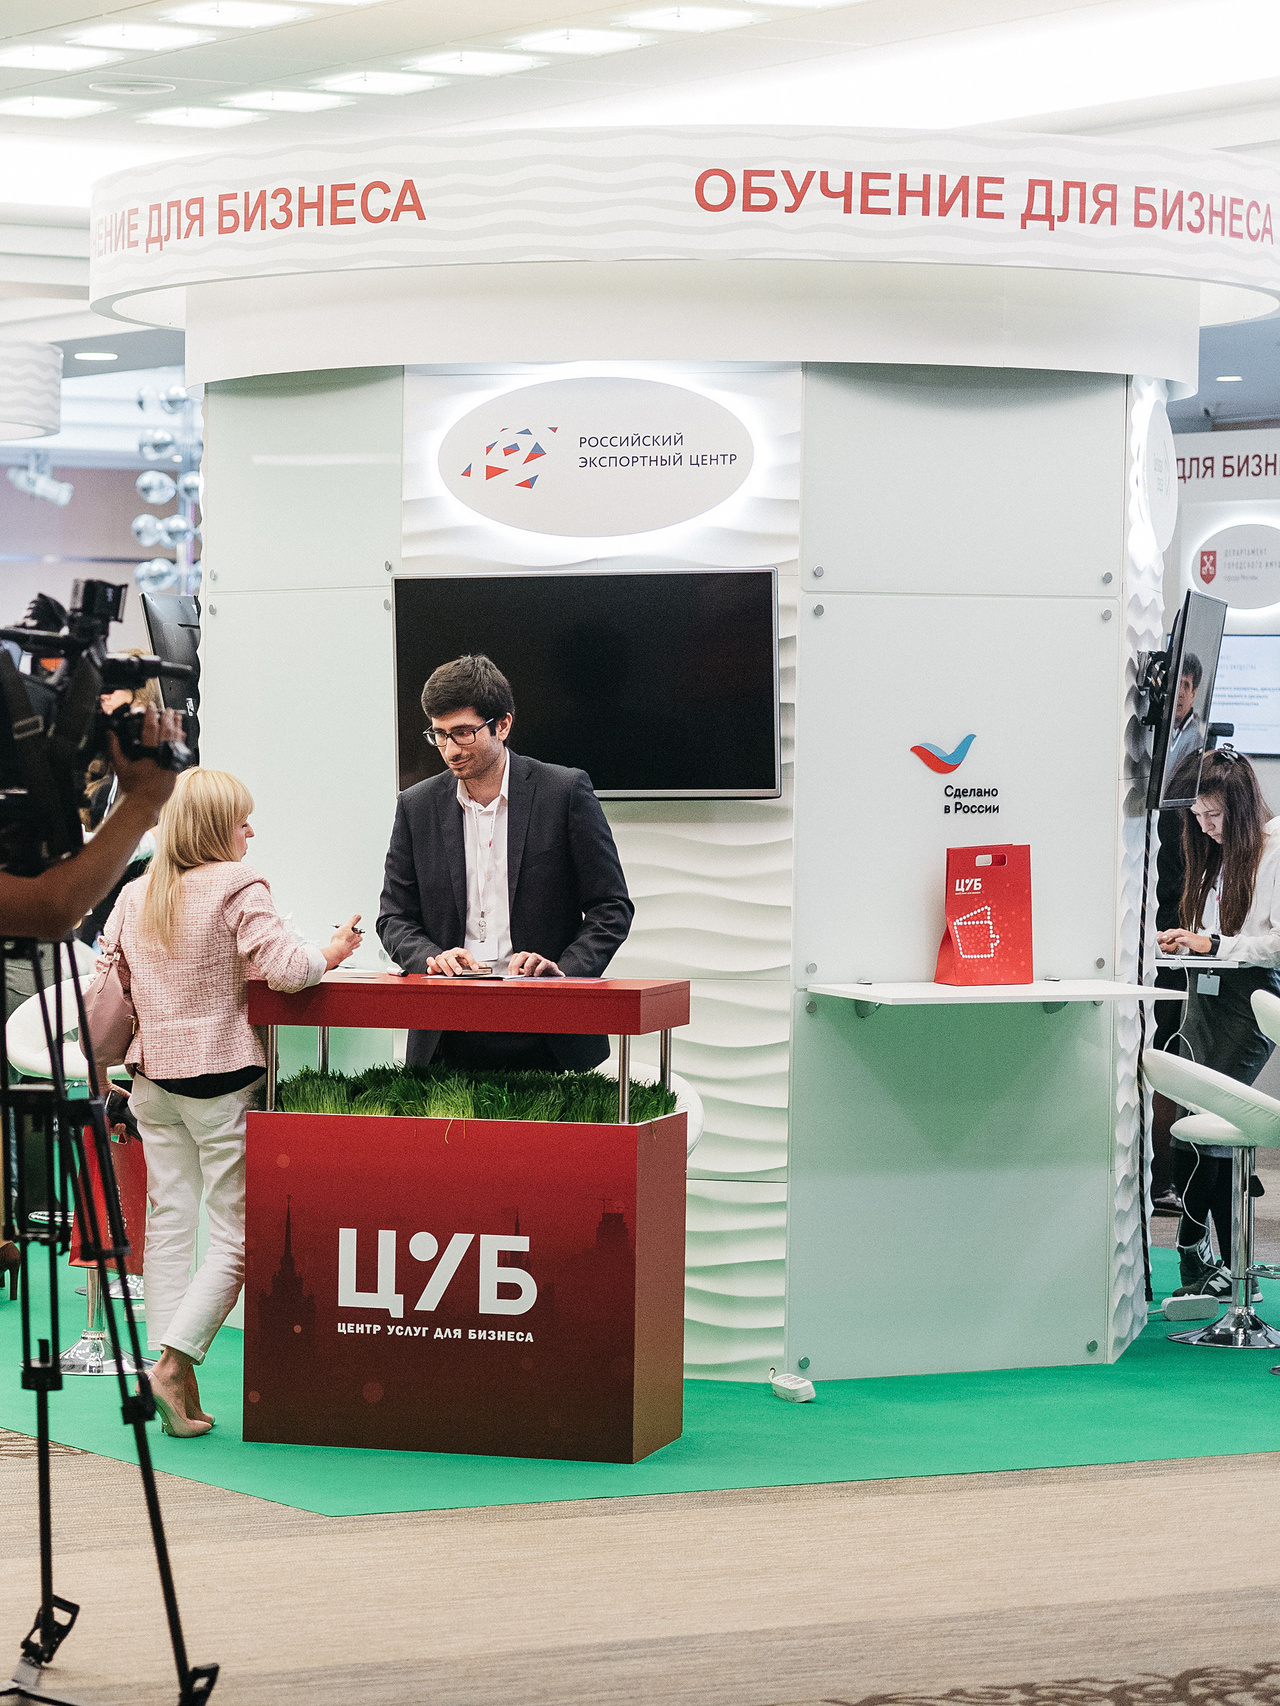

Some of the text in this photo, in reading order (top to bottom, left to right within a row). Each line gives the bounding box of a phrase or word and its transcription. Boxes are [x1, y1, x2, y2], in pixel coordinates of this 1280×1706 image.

[695, 168, 1274, 245] ОБУЧЕНИЕ ДЛЯ БИЗНЕСА
[95, 179, 426, 257] ЕНИЕ ДЛЯ БИЗНЕСА
[579, 432, 684, 448] РОССИЙСКИЙ
[578, 452, 738, 468] ЭКСПОРТНЫЙ ЦЕНТР
[1176, 456, 1215, 484] ДЛЯ
[1222, 453, 1280, 478] БИЗН
[944, 784, 999, 799] Сделано
[944, 801, 1000, 814] в России
[955, 877, 982, 893] ЦУБ
[337, 1228, 538, 1319] ЦУБ
[337, 1322, 534, 1343] ЦЕНТР УСЛУГ ДЛЯ БИЗНЕСА
